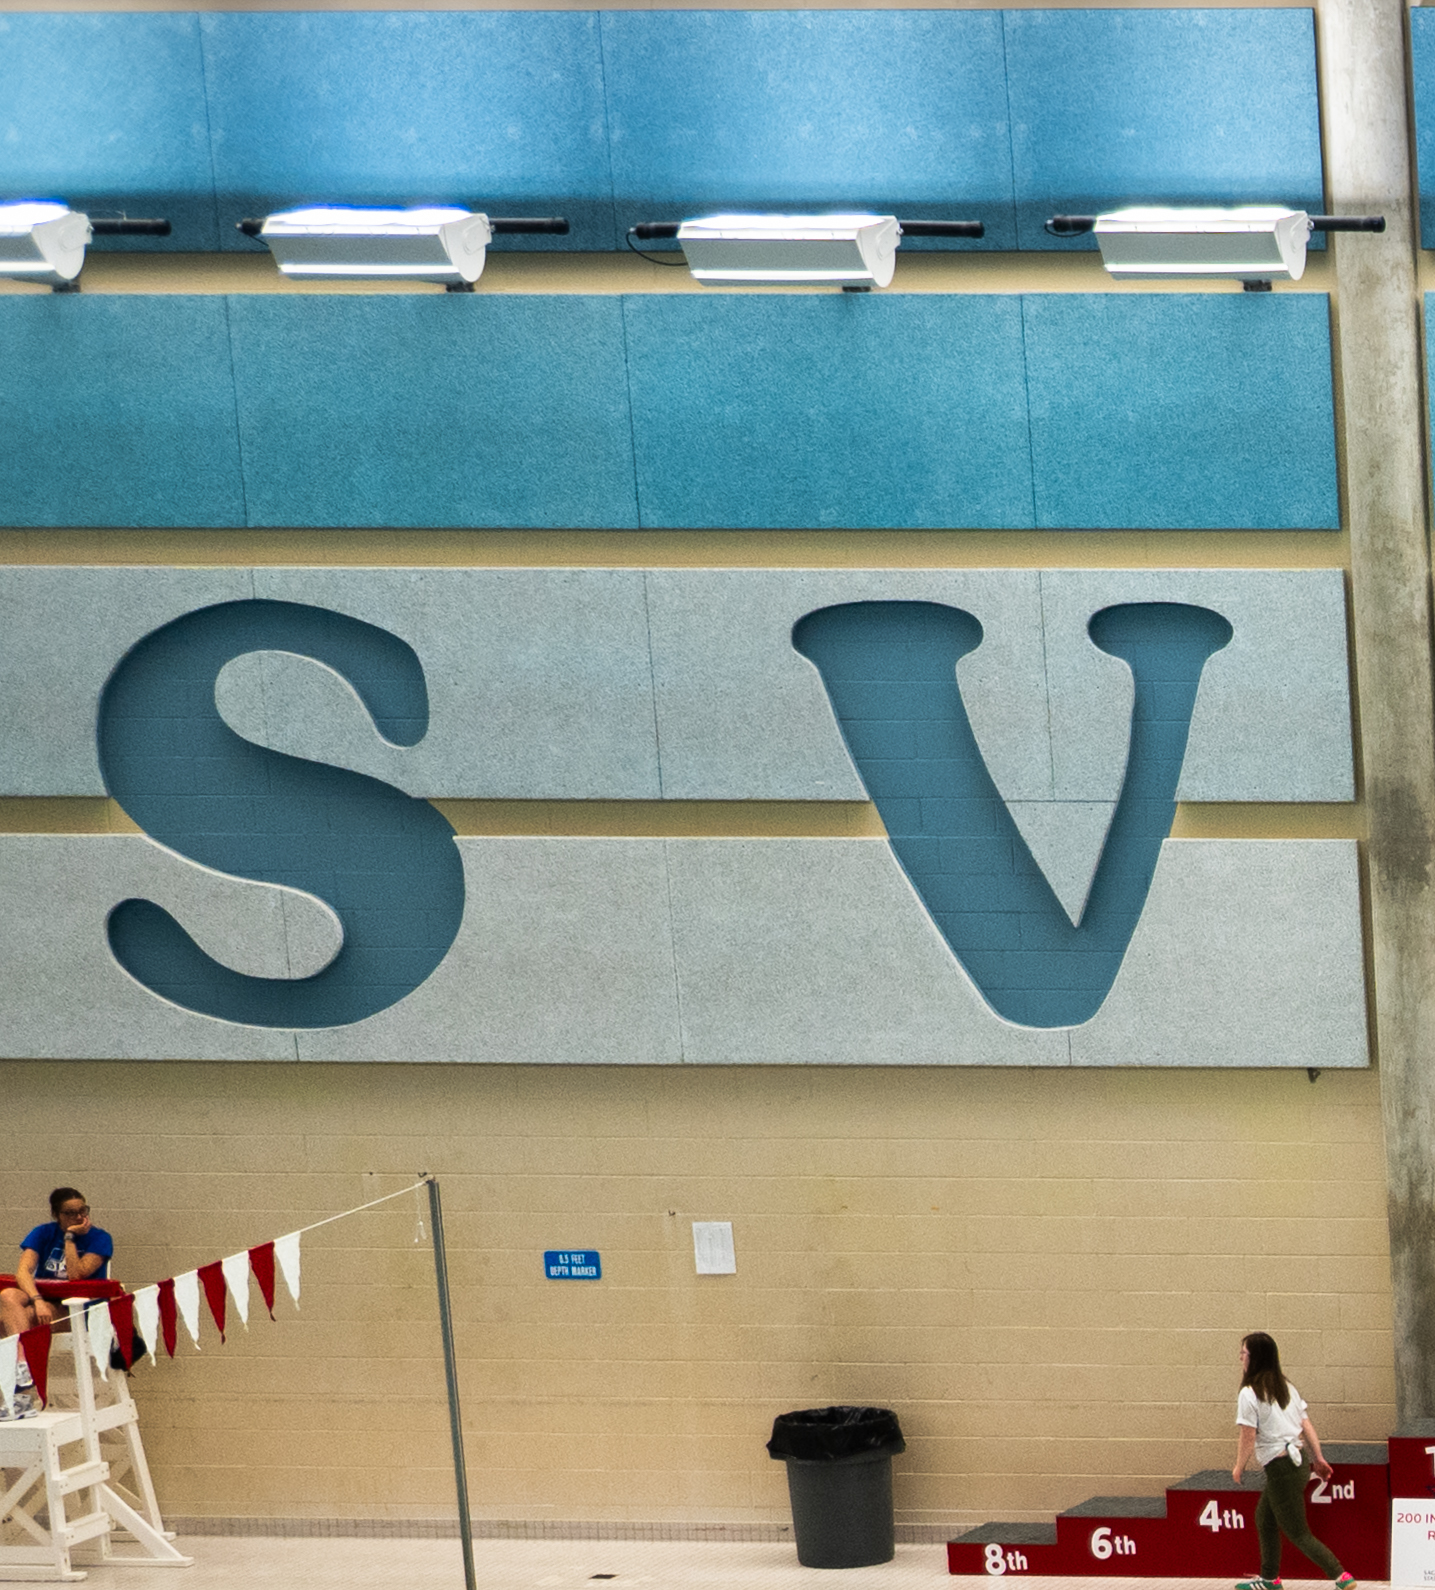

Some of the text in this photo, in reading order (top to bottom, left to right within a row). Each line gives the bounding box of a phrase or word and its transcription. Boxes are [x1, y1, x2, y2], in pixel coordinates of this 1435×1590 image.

[550, 1265, 597, 1276] DEPTH MARKER
[571, 1253, 585, 1264] FEET
[1310, 1471, 1355, 1504] 2nd
[1199, 1500, 1245, 1533] 4th
[1397, 1513, 1422, 1524] 200
[984, 1543, 1028, 1576] 8th
[1090, 1527, 1137, 1560] 6th
